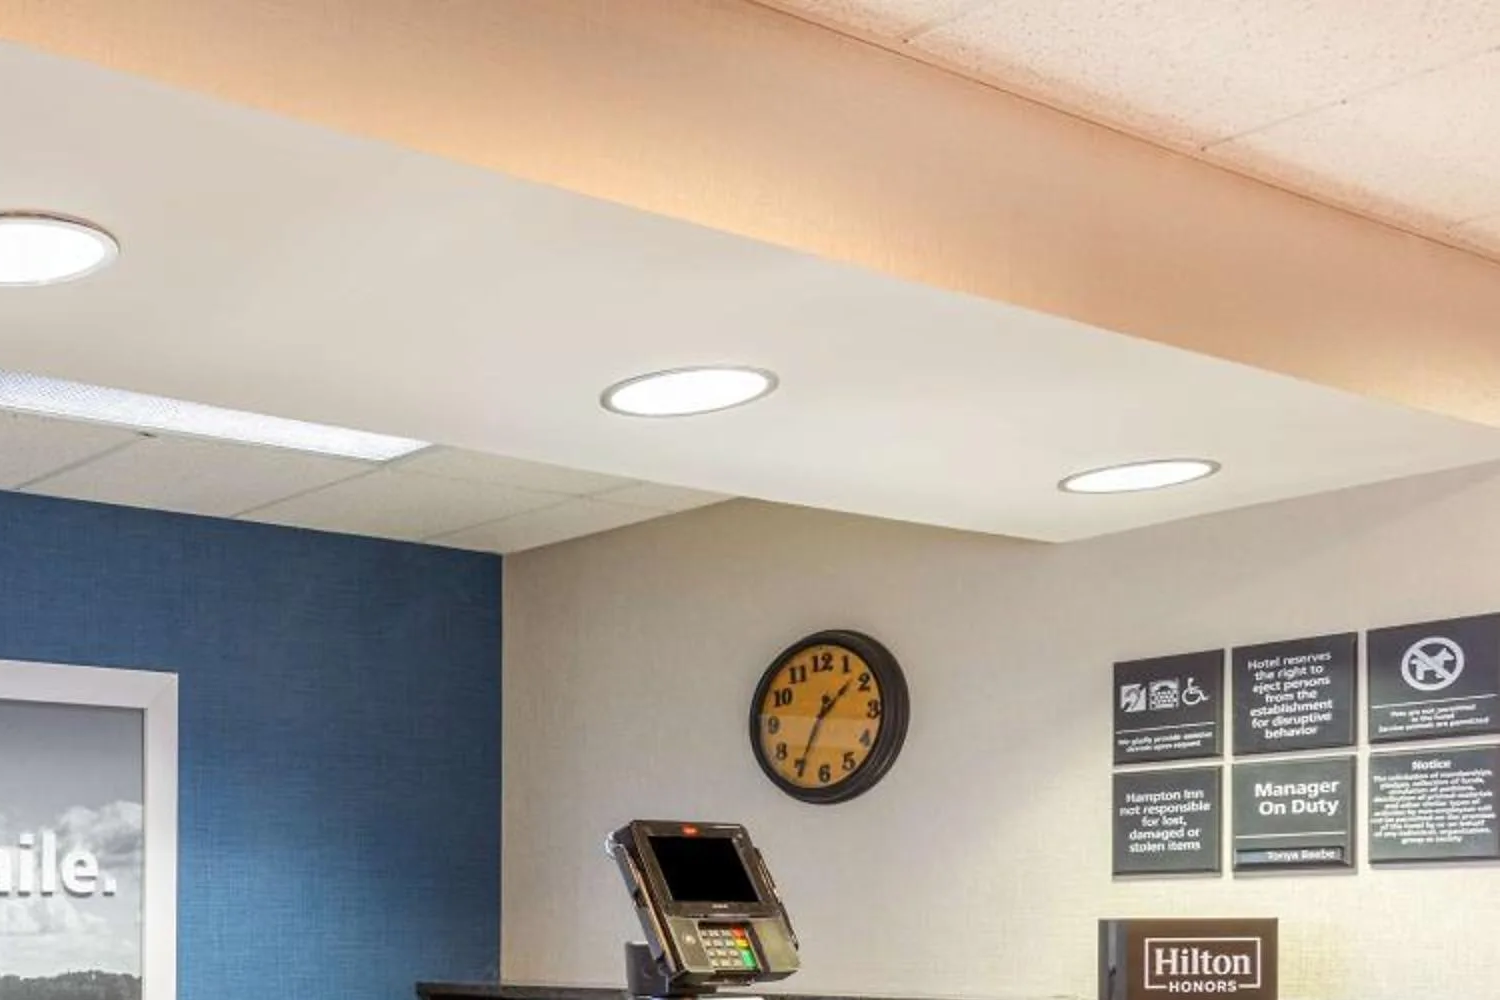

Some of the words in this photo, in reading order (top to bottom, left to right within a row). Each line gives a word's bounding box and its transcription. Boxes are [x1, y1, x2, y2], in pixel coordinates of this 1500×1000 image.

[811, 653, 834, 672] 12
[842, 655, 851, 673] 1
[1247, 657, 1280, 671] Hotel
[1283, 653, 1331, 665] reserves
[789, 665, 806, 684] 11
[1255, 670, 1275, 681] the
[1277, 667, 1307, 681] right
[1309, 665, 1324, 674] to
[858, 673, 870, 692] 2
[1252, 681, 1281, 695] eject
[1284, 677, 1331, 692] persons
[774, 688, 792, 707] 10
[1265, 693, 1295, 703] from
[1297, 689, 1318, 700] the
[867, 700, 880, 719] 3
[1250, 699, 1333, 717] establishment
[768, 716, 780, 734] 9
[1252, 717, 1270, 729] for
[1271, 712, 1333, 728] disruptive
[859, 729, 871, 746] 4
[1264, 726, 1318, 739] behavior
[776, 742, 787, 760] 8
[794, 759, 806, 777] 7
[842, 752, 855, 770] 5
[819, 764, 830, 782] 6
[1125, 791, 1181, 804] Hampton
[1183, 789, 1204, 799] Inn
[1254, 781, 1340, 798] Manager
[1119, 806, 1141, 816] not
[1143, 800, 1211, 816] responsible
[1259, 801, 1287, 815] On
[1291, 799, 1339, 817] Duty
[1141, 816, 1160, 827] for
[1129, 827, 1185, 841] damaged
[1187, 828, 1200, 838] or
[1129, 842, 1165, 853] stolen
[1167, 840, 1201, 851] items
[1154, 947, 1252, 976] Hilton
[1169, 980, 1237, 993] HONORS
